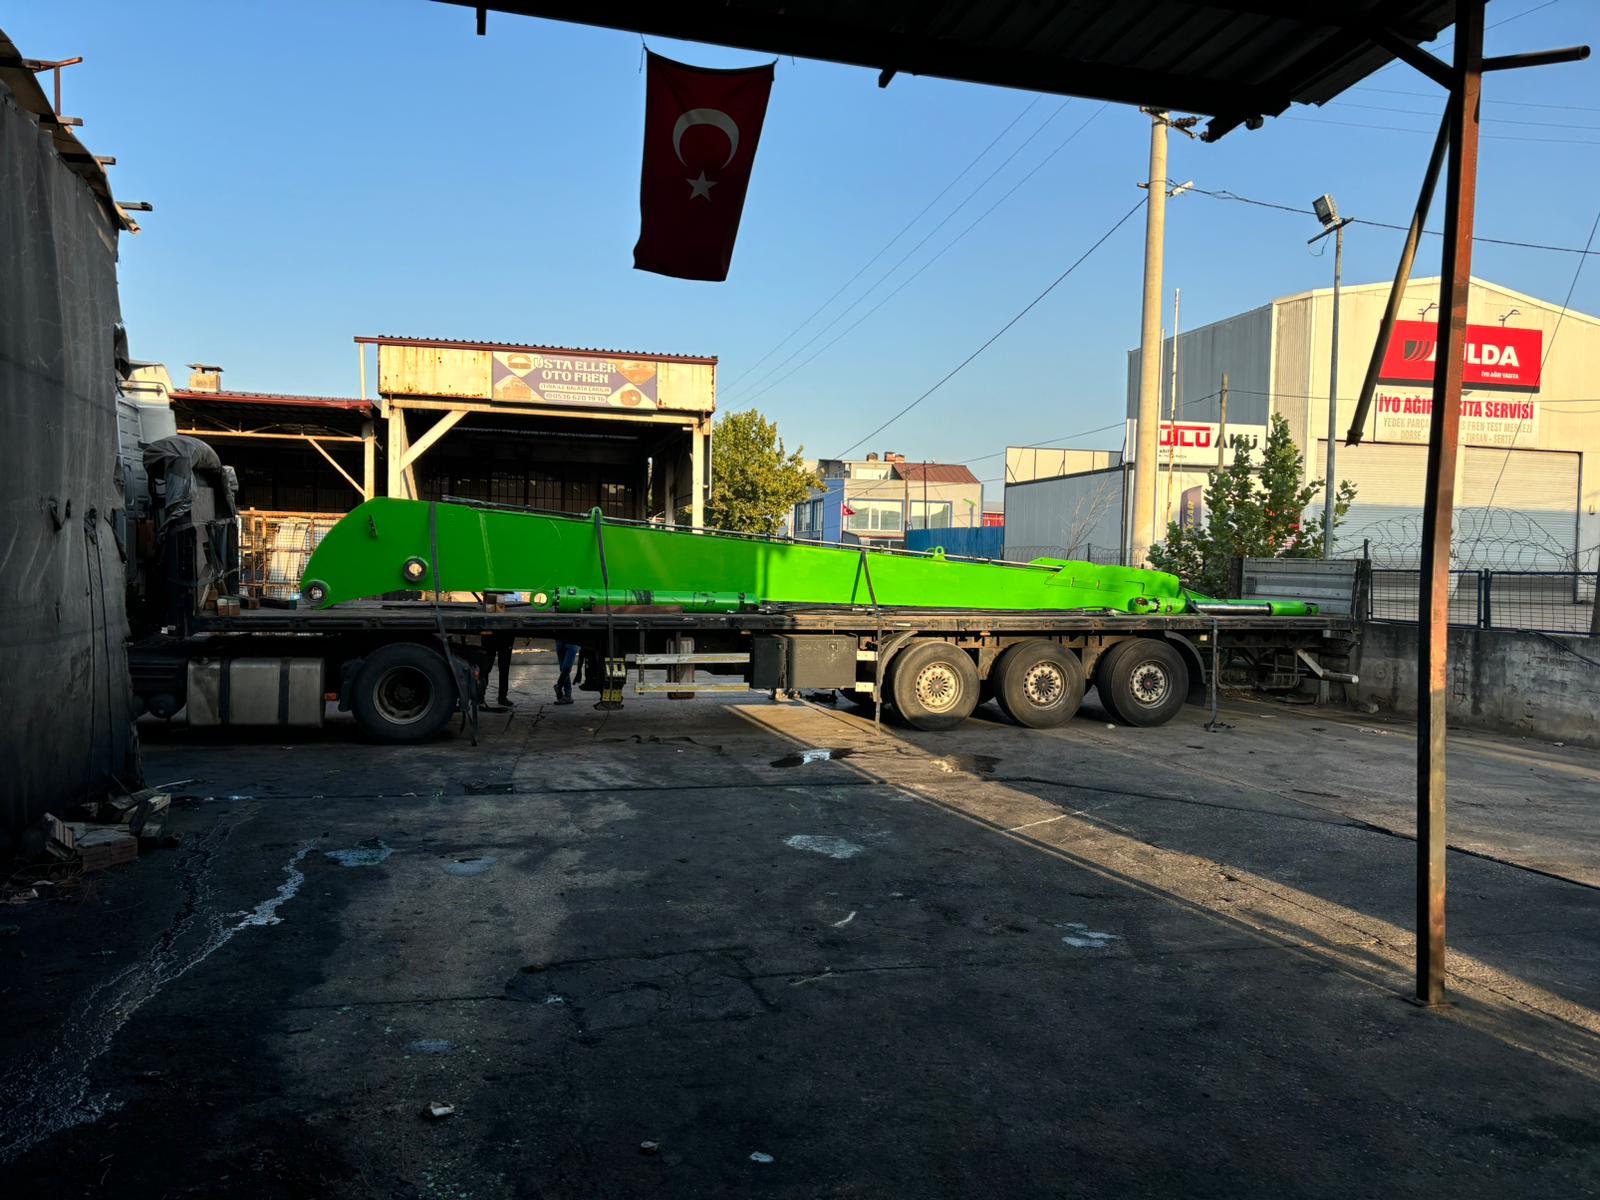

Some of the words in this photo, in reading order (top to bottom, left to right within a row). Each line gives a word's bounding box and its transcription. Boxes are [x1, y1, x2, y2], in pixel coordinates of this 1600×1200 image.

[575, 361, 616, 373] ELLER
[542, 370, 571, 381] OTO
[575, 372, 608, 383] FREN
[1378, 393, 1400, 413] İYO
[1485, 401, 1534, 420] SERVİSİ
[1486, 421, 1503, 432] TEST
